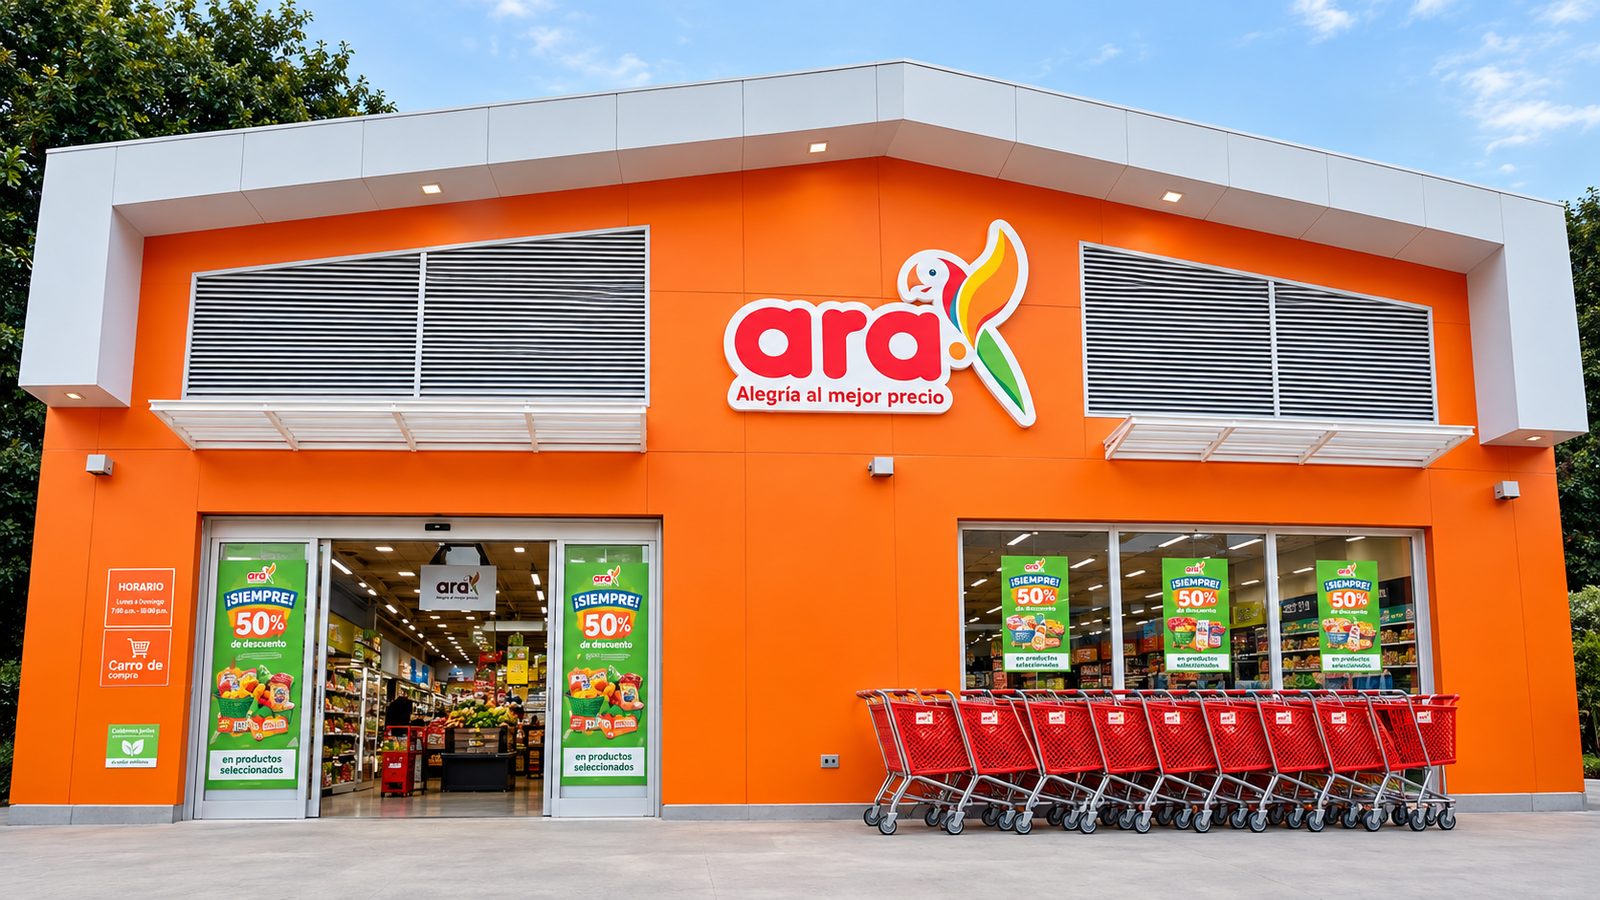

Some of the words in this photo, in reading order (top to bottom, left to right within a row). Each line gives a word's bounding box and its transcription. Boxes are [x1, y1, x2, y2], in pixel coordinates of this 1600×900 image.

[735, 307, 942, 381] ara
[736, 385, 800, 405] Alegría
[806, 387, 822, 402] al
[828, 388, 881, 407] mejor
[888, 389, 945, 407] precio
[118, 582, 164, 591] HORARIO
[1011, 576, 1060, 587] ¡SIEMPRE!
[1172, 578, 1220, 589] ¡SIEMPRE!
[436, 582, 469, 594] ara
[226, 590, 295, 607] ¡SIEMPRE!
[574, 593, 640, 609] ¡SIEMPRE!
[1017, 587, 1056, 605] 50%
[1178, 590, 1216, 607] 50%
[1332, 591, 1368, 608] 50%
[236, 611, 284, 636] 50%
[585, 613, 631, 637] 50%
[231, 640, 242, 648] de
[243, 639, 287, 648] descuento
[580, 640, 590, 649] de
[592, 640, 633, 648] descuento
[109, 660, 143, 671] Carro
[147, 659, 163, 670] de
[235, 754, 282, 765] productos
[588, 752, 632, 762] productos
[220, 765, 284, 774] seleccionados
[573, 763, 634, 771] seleccionados
